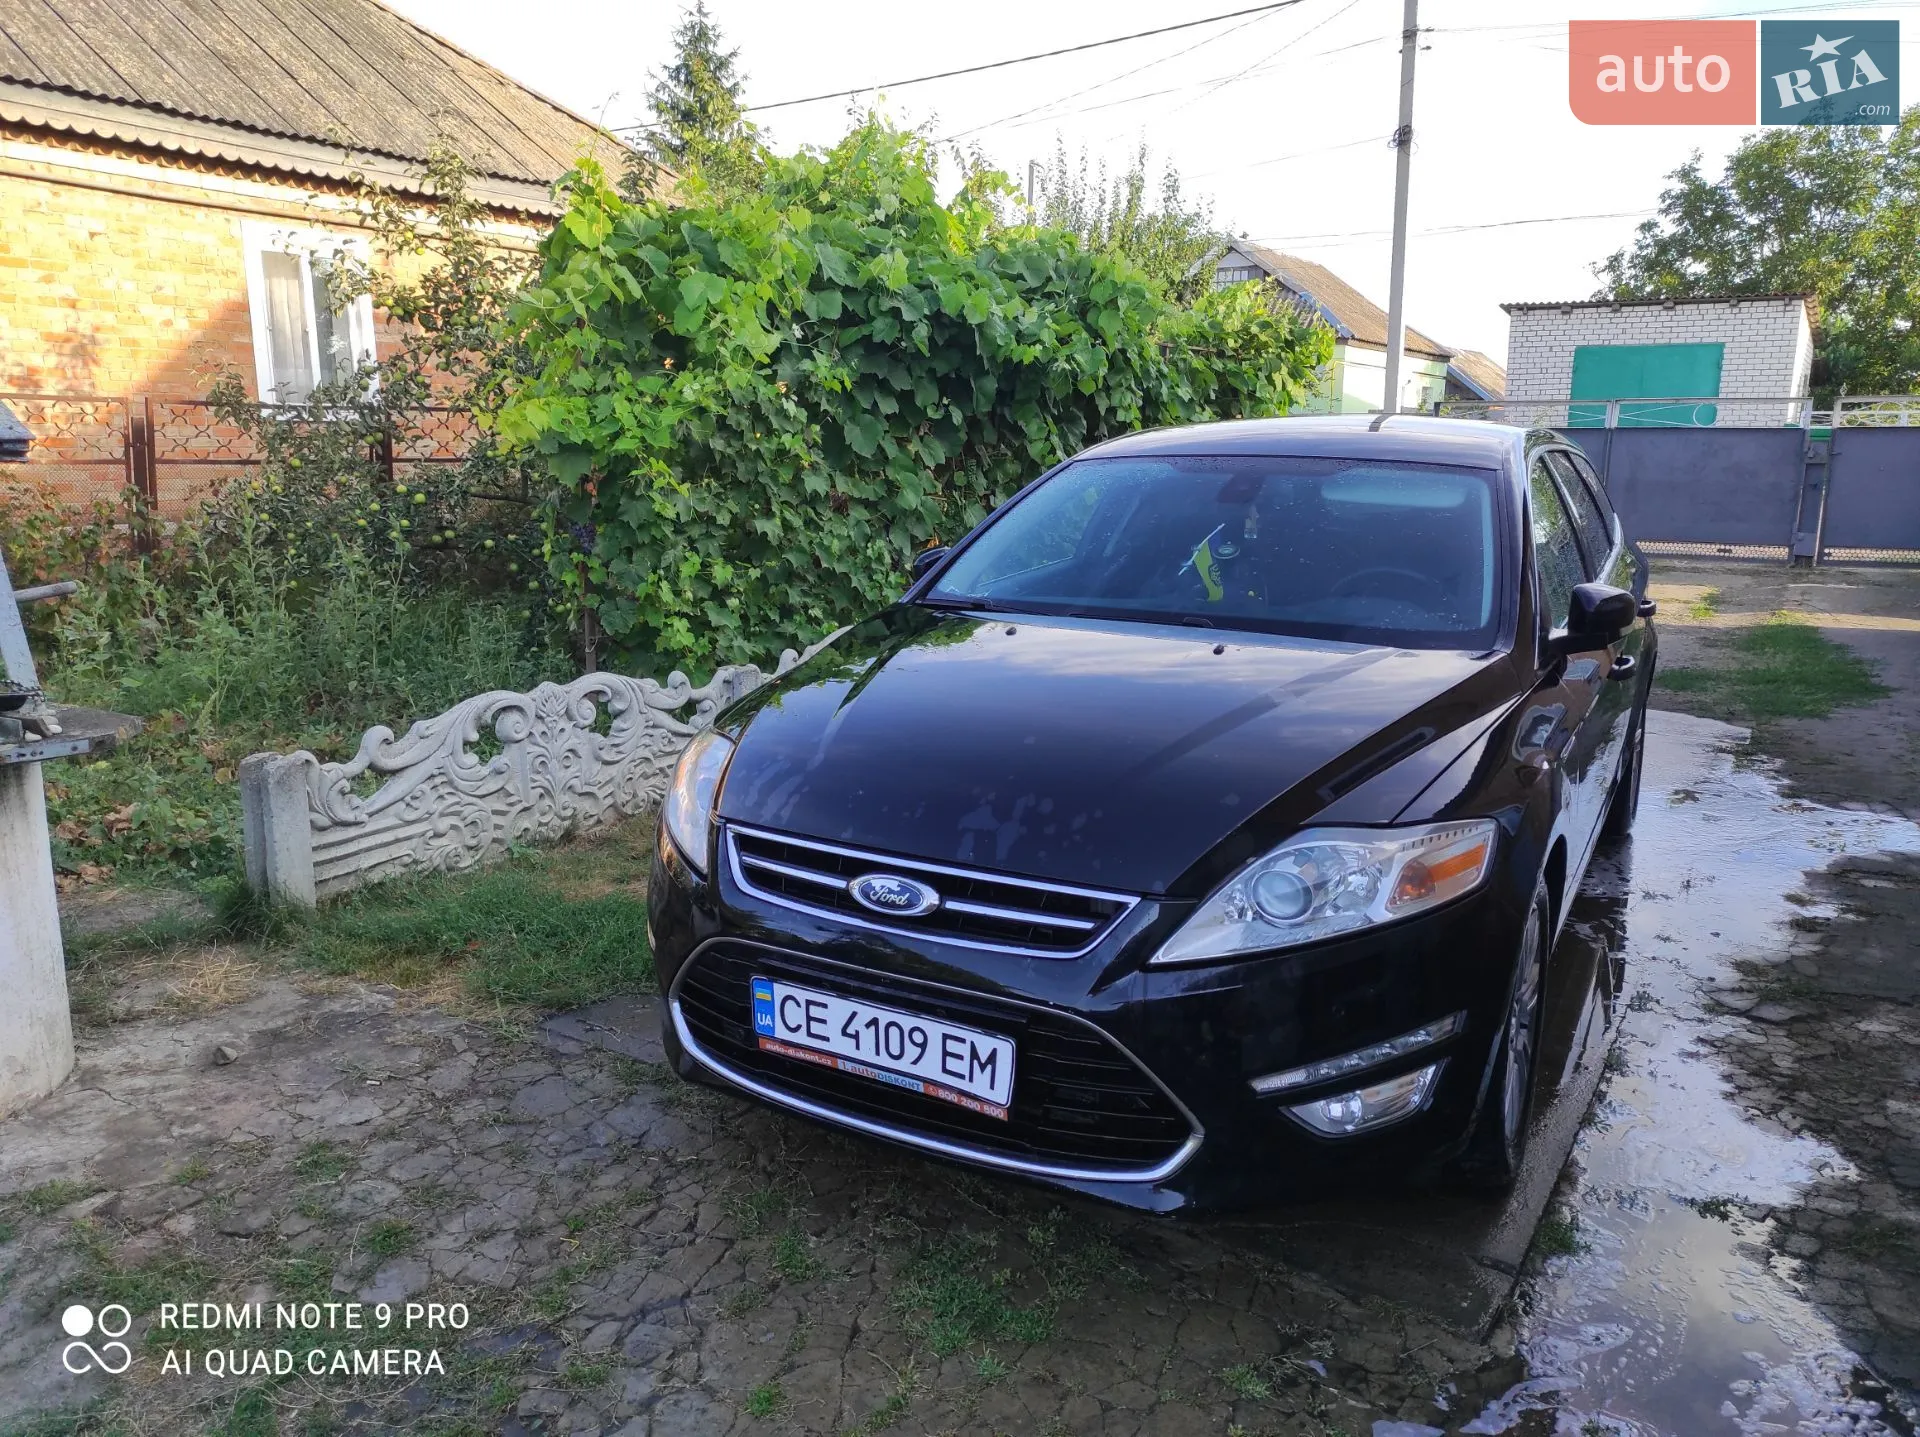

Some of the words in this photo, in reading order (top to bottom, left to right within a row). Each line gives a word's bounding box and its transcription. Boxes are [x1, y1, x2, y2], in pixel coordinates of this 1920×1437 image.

[869, 882, 910, 905] Ford
[758, 1012, 773, 1028] UA
[779, 993, 830, 1042] CE
[841, 1010, 929, 1065] 4109
[941, 1032, 998, 1091] EM
